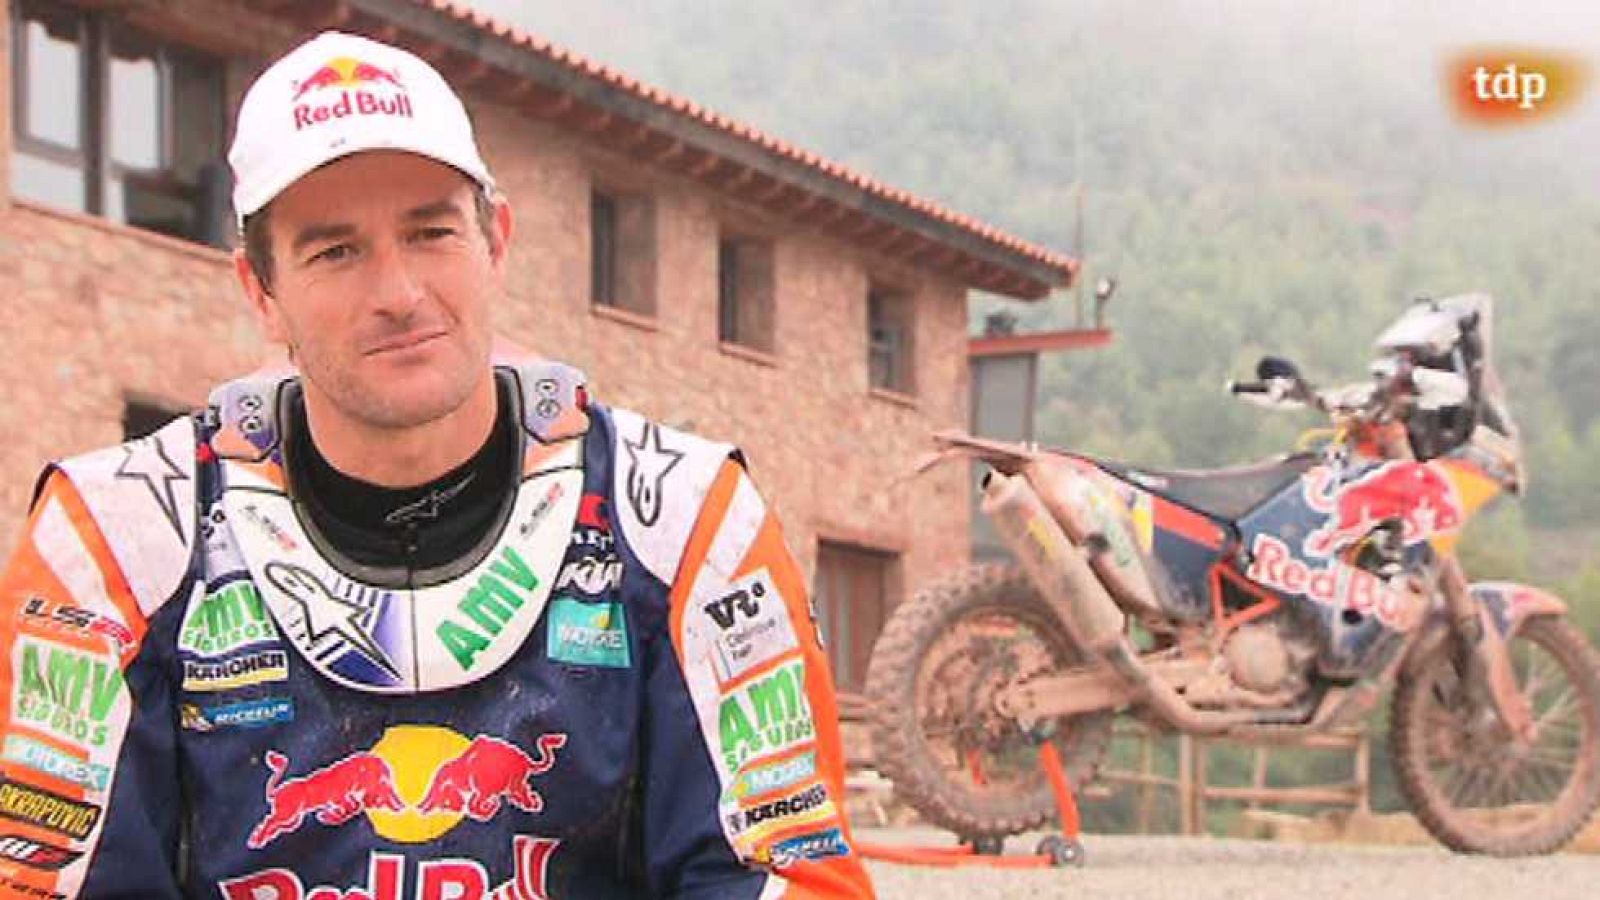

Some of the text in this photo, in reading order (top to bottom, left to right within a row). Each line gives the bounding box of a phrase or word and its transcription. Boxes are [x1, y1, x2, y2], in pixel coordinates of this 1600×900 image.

[293, 91, 413, 131] Red Bull
[186, 584, 264, 637] AMV
[435, 546, 539, 671] AMV
[1247, 534, 1426, 632] Red Bu
[20, 642, 123, 723] AMV
[218, 835, 561, 900] Rd Bll
